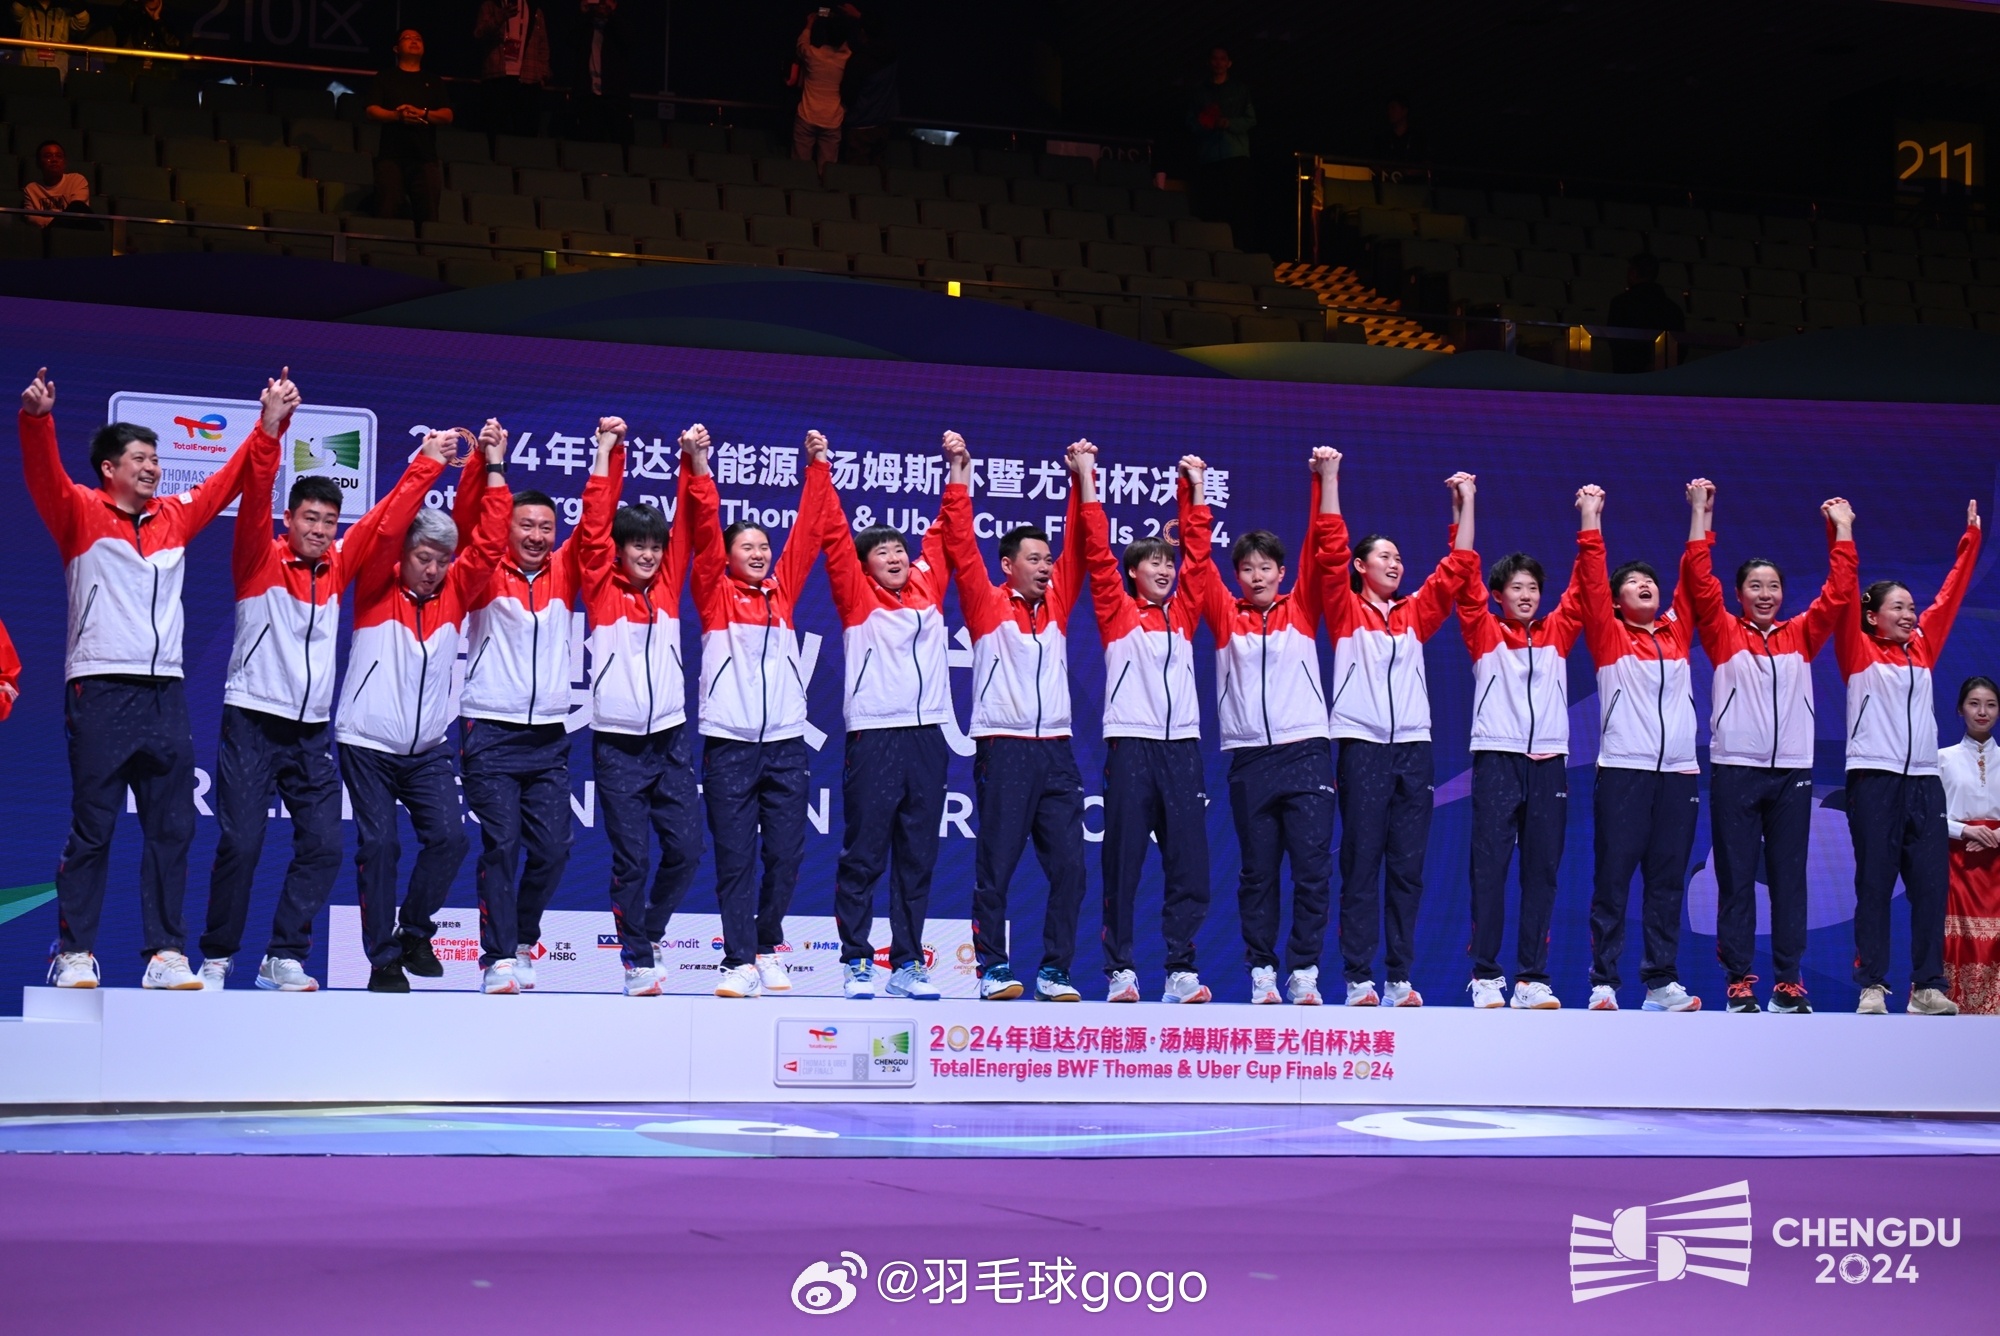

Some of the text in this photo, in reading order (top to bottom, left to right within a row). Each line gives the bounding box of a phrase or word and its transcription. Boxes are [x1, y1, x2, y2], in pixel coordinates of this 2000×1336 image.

[1897, 140, 1974, 195] 211
[173, 442, 227, 453] TotalEnergies
[162, 468, 205, 483] THOMAS
[161, 482, 180, 494] CUP
[852, 505, 877, 533] &
[661, 938, 700, 949] oundit
[549, 952, 577, 961] HSBC
[874, 1058, 909, 1066] CHENGDU
[930, 1058, 1394, 1083] TotalEnergies BWF Thomas & Uber Cup Finals 2024
